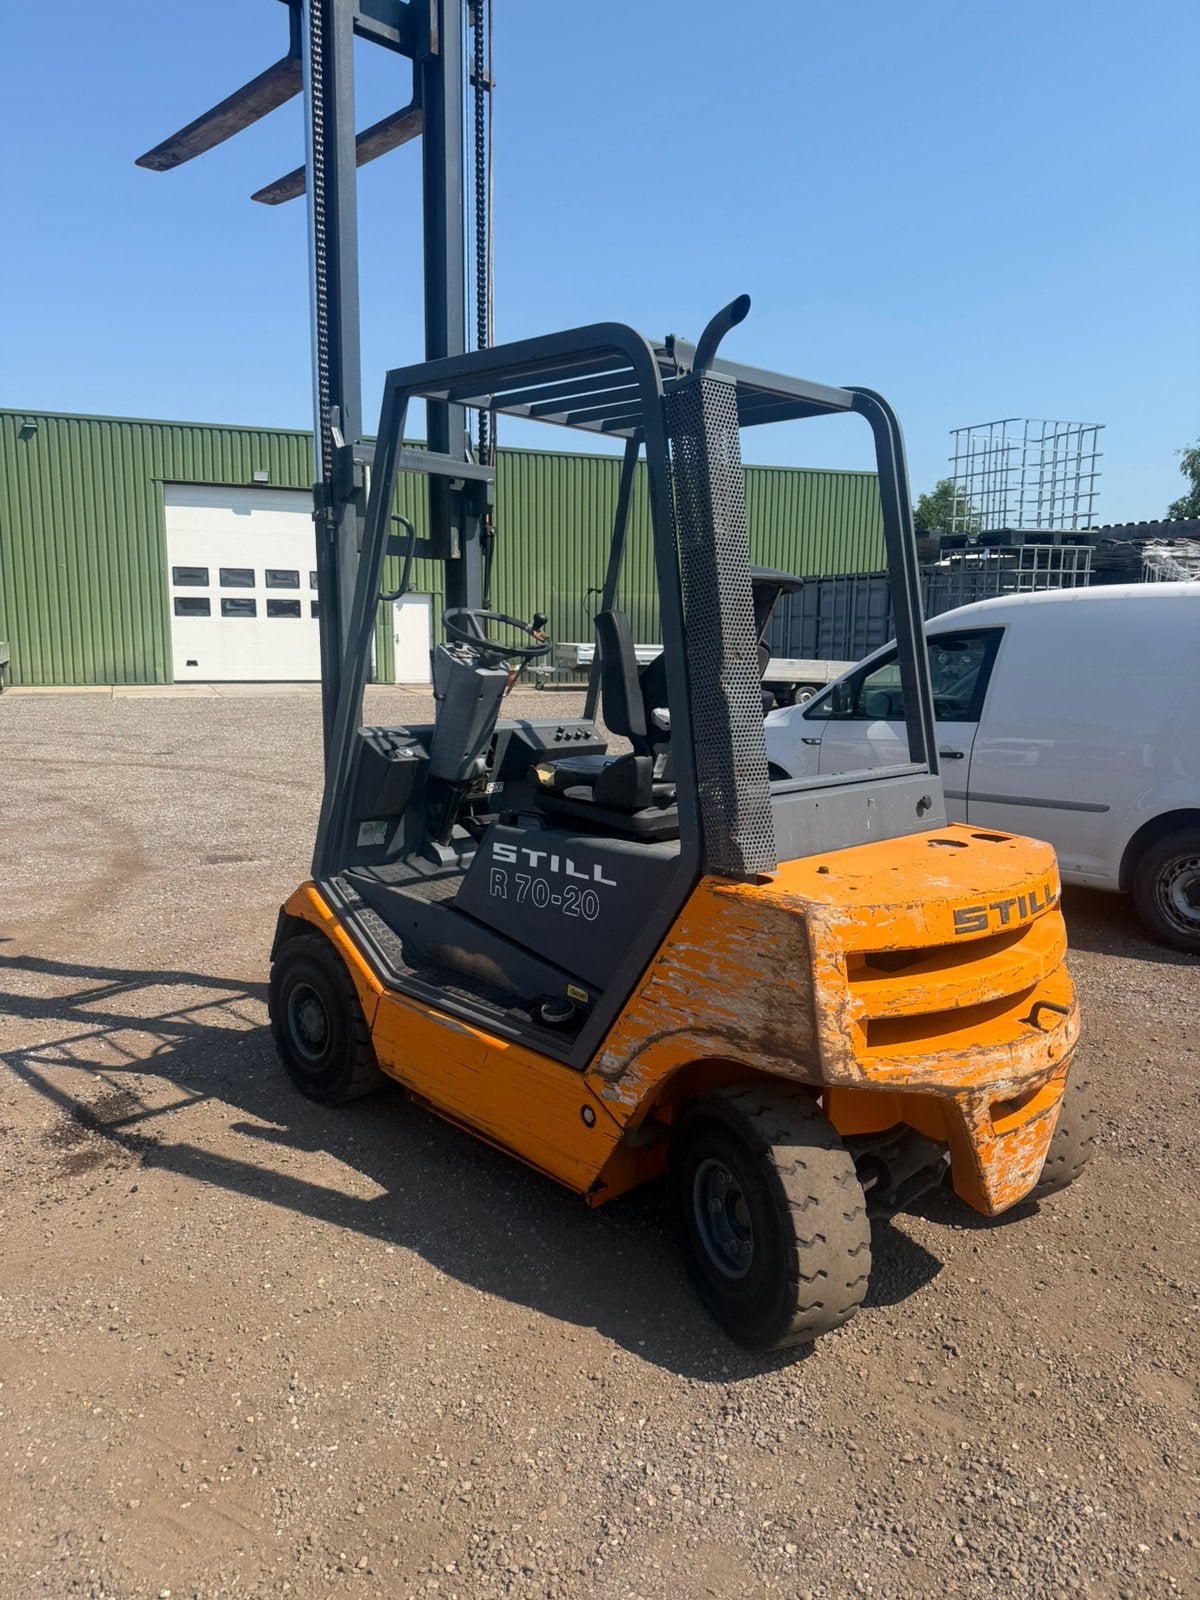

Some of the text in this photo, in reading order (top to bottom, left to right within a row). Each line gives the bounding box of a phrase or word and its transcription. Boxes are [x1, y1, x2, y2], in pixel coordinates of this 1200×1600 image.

[492, 842, 617, 887] STILL
[490, 867, 600, 921] R 70-20
[953, 883, 1057, 935] STILL
